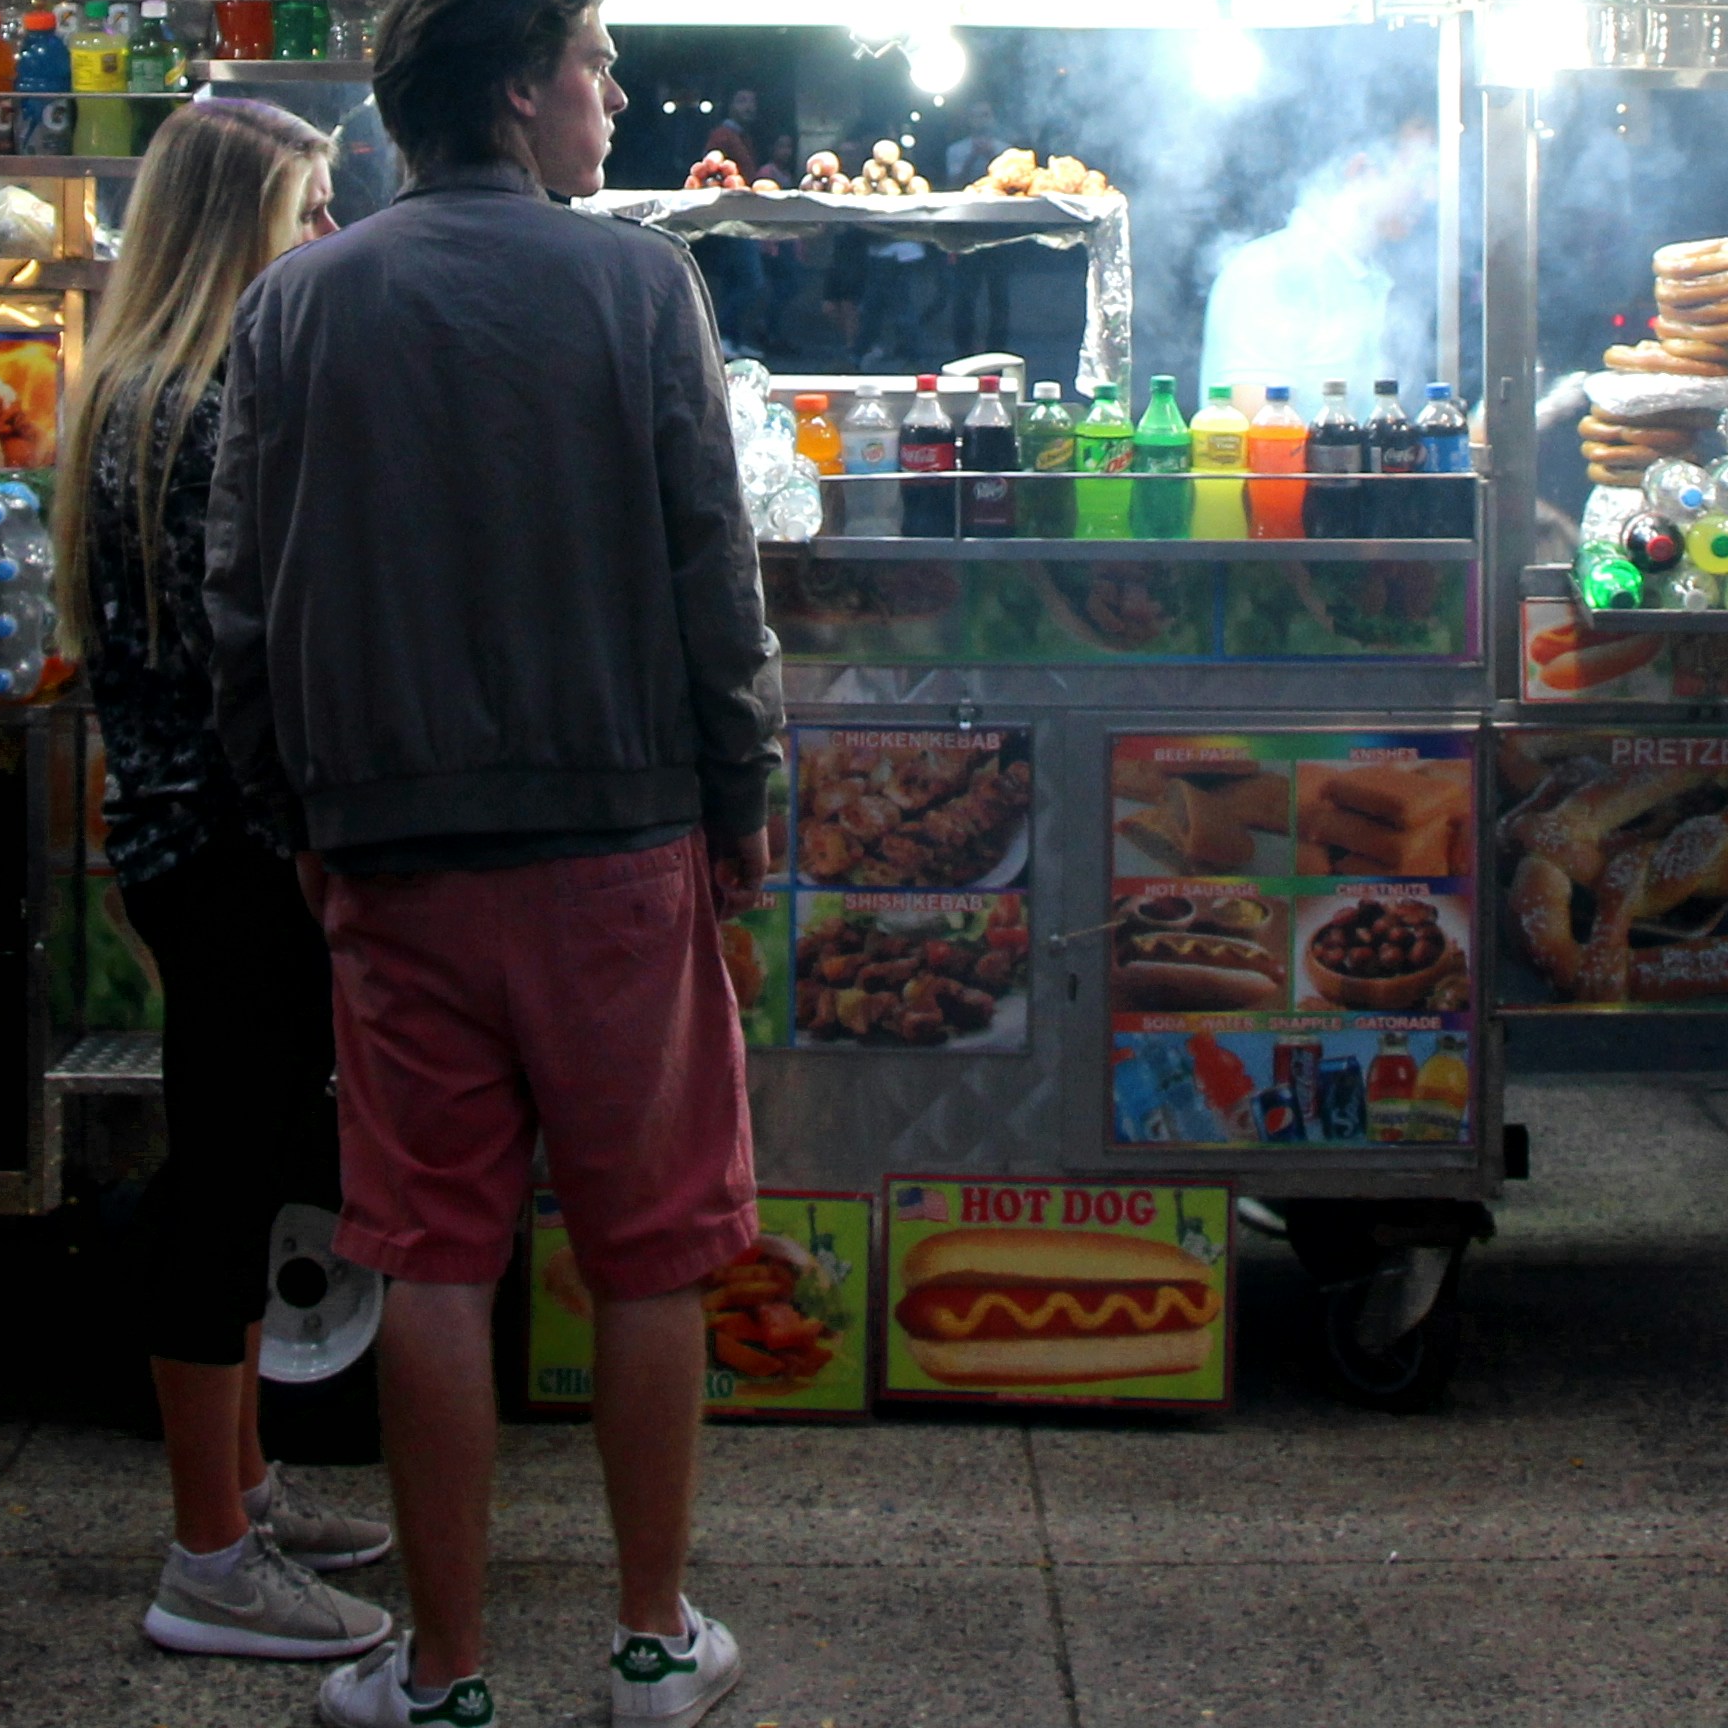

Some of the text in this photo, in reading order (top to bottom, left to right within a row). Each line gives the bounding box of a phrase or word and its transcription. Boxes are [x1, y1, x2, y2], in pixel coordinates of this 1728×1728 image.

[830, 730, 1002, 751] CHICKEN KEBAB
[1144, 882, 1260, 898] HOT SAUSAGE
[844, 892, 984, 913] SHISH KEBAB
[1141, 1015, 1187, 1032] SODA
[1267, 1015, 1345, 1032] SNAPPLE
[1353, 1014, 1443, 1032] GATORADE
[961, 1187, 1157, 1227] HOT DOG
